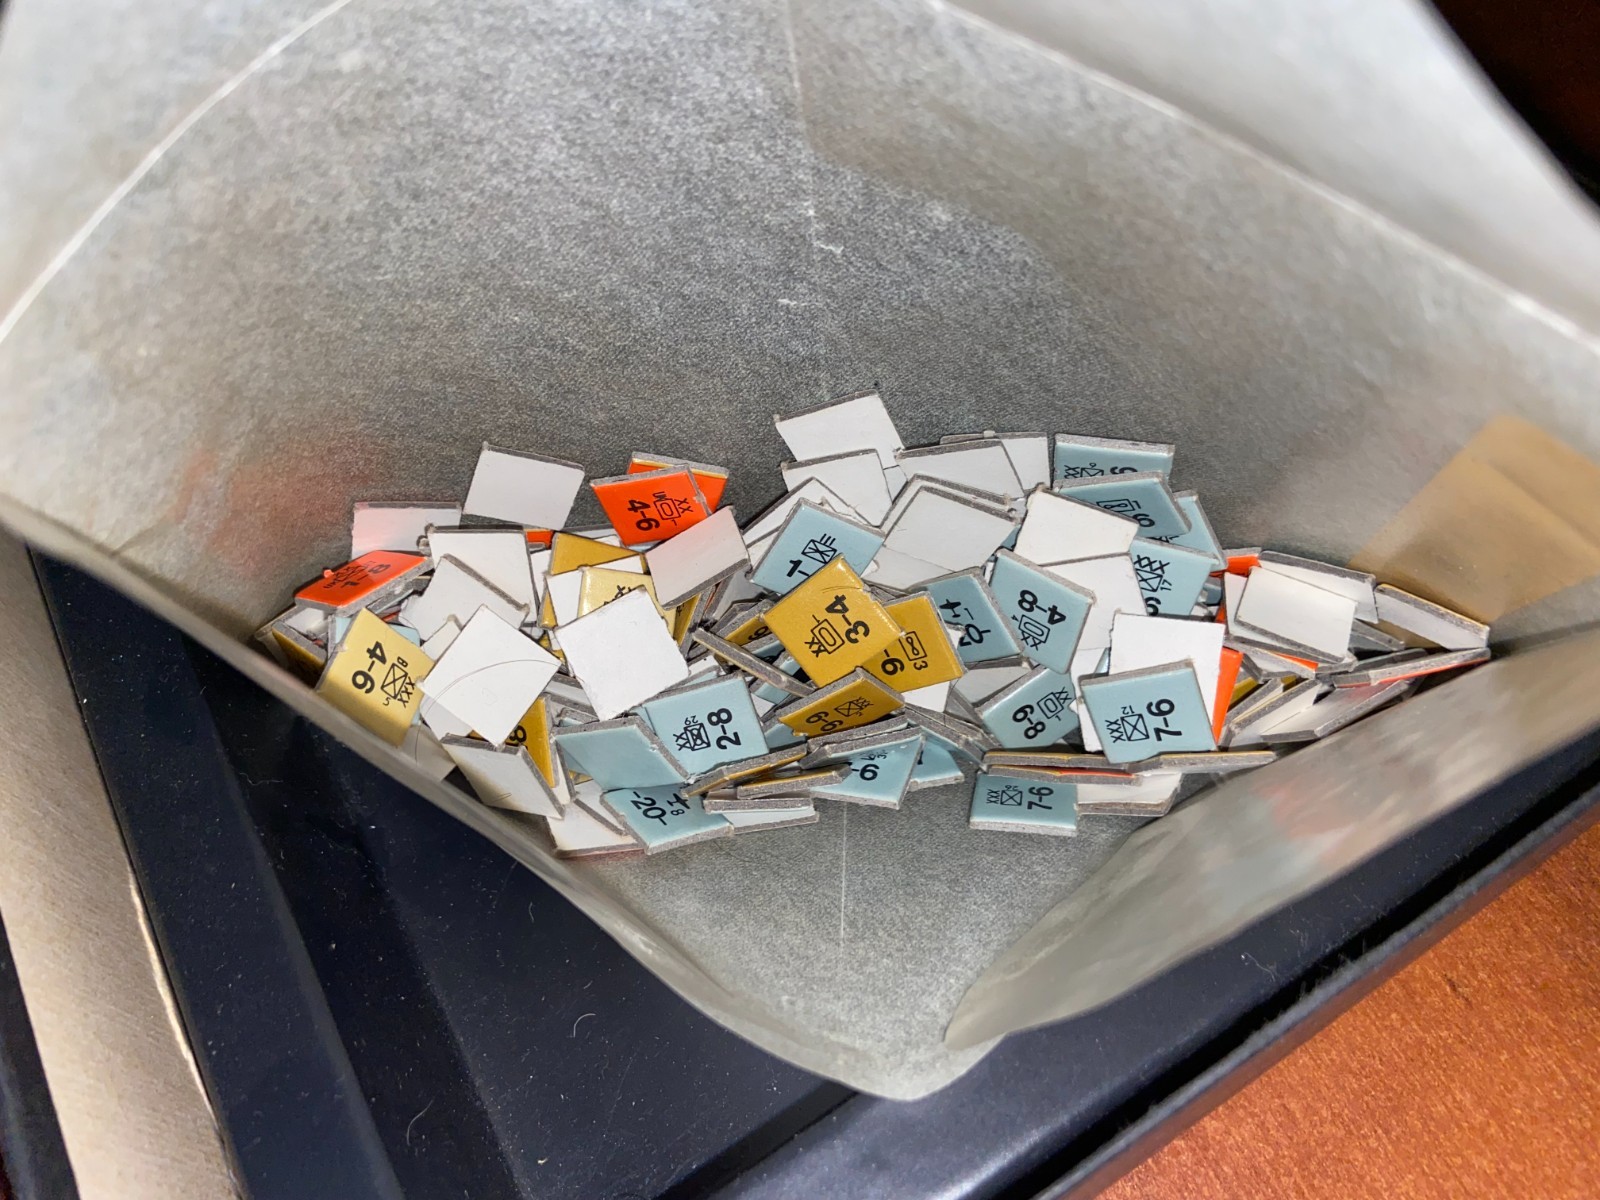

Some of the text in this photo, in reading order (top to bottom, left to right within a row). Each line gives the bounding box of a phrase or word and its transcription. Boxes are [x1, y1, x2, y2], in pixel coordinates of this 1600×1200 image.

[627, 499, 660, 531] 4-6
[824, 594, 870, 644] 3-4
[1017, 589, 1067, 625] 4-8
[351, 641, 387, 694] 4-6
[913, 660, 929, 671] 3
[397, 676, 416, 708] XXX
[805, 711, 844, 732] 6-6
[1012, 704, 1046, 739] 6-8
[1121, 705, 1136, 715] 12
[1146, 698, 1183, 742] 7-6
[707, 708, 742, 750] 2-8
[1027, 786, 1054, 810] 7-6
